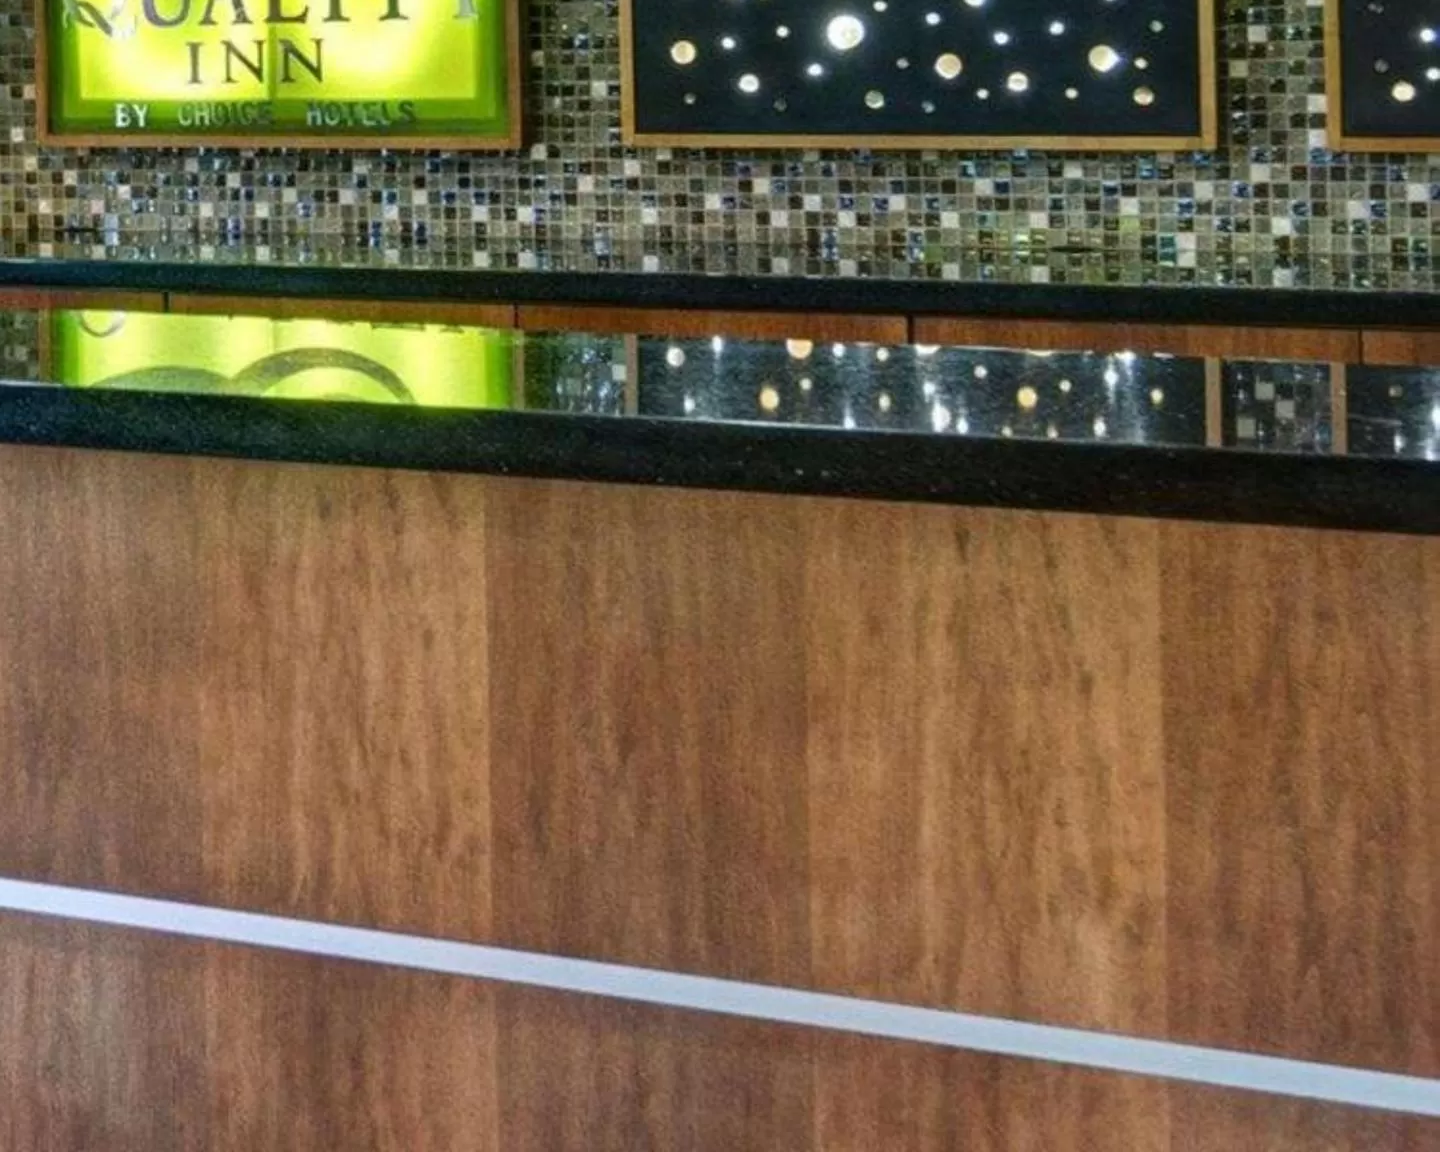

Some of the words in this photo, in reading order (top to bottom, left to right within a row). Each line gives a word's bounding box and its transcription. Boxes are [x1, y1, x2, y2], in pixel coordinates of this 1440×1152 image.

[186, 38, 324, 84] INN
[115, 103, 149, 128] BY
[178, 101, 273, 127] CHOICE
[306, 99, 416, 127] HOTELS
